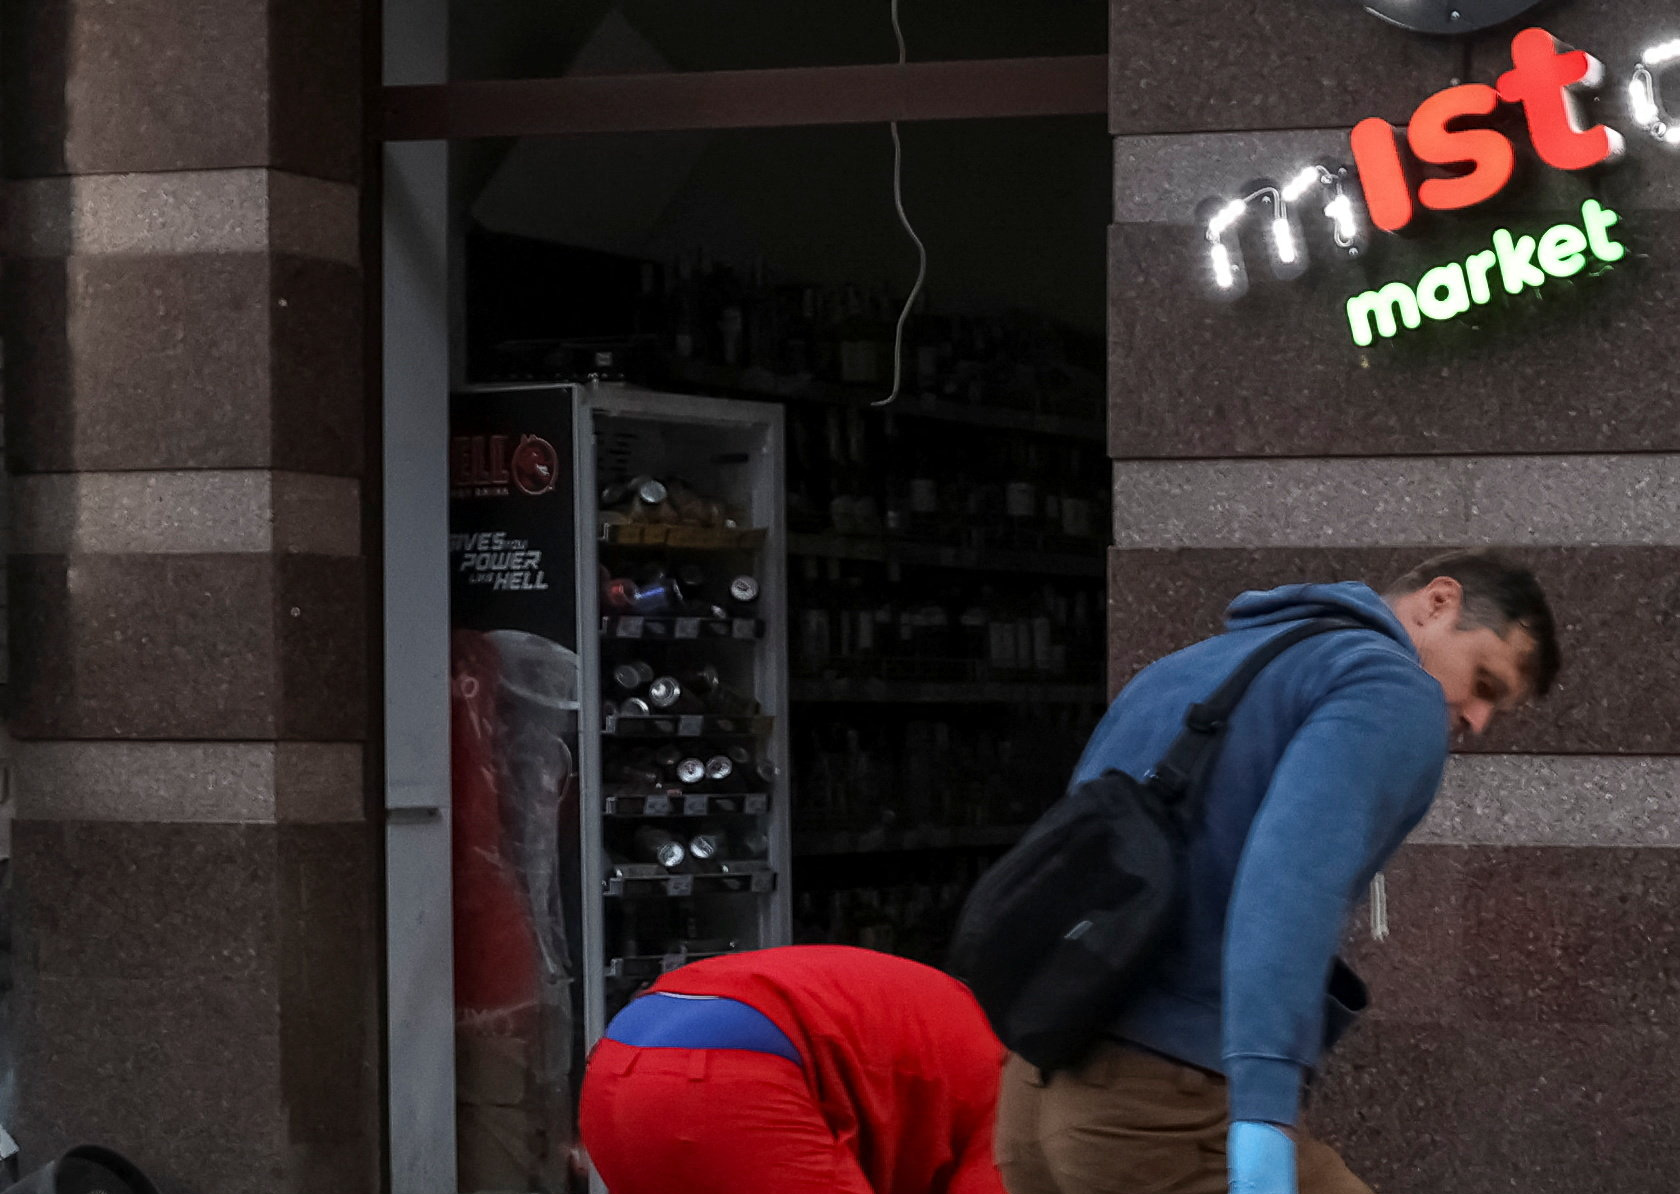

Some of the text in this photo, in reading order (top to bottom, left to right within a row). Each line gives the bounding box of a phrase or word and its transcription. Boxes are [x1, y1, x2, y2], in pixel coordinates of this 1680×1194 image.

[1347, 199, 1624, 347] market
[451, 434, 510, 485] ELL
[459, 549, 543, 572] POWER
[492, 570, 549, 592] HELL
